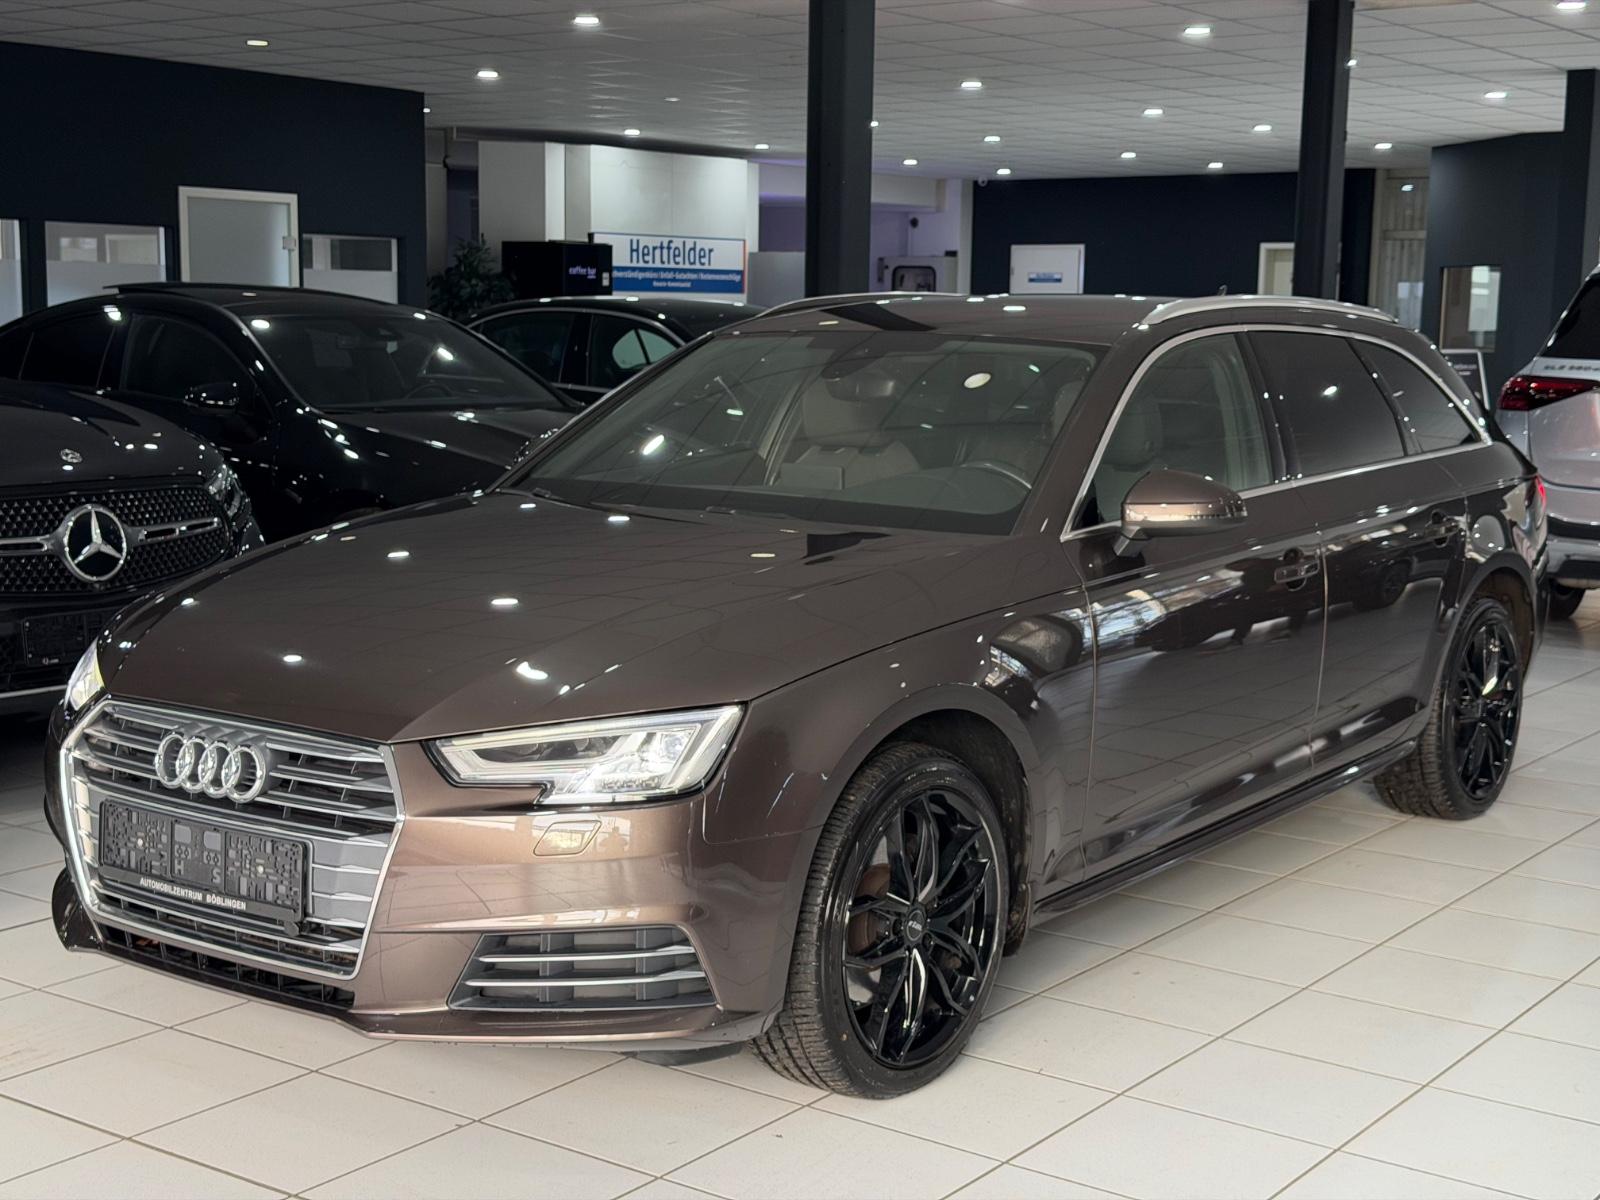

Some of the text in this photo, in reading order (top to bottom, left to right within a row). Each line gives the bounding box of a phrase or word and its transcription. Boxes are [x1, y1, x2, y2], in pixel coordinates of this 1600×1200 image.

[629, 238, 715, 267] Hertfelder
[568, 265, 587, 275] coffee
[139, 876, 247, 911] AUTOMOBILZENTRUM BÖBLINGEN
